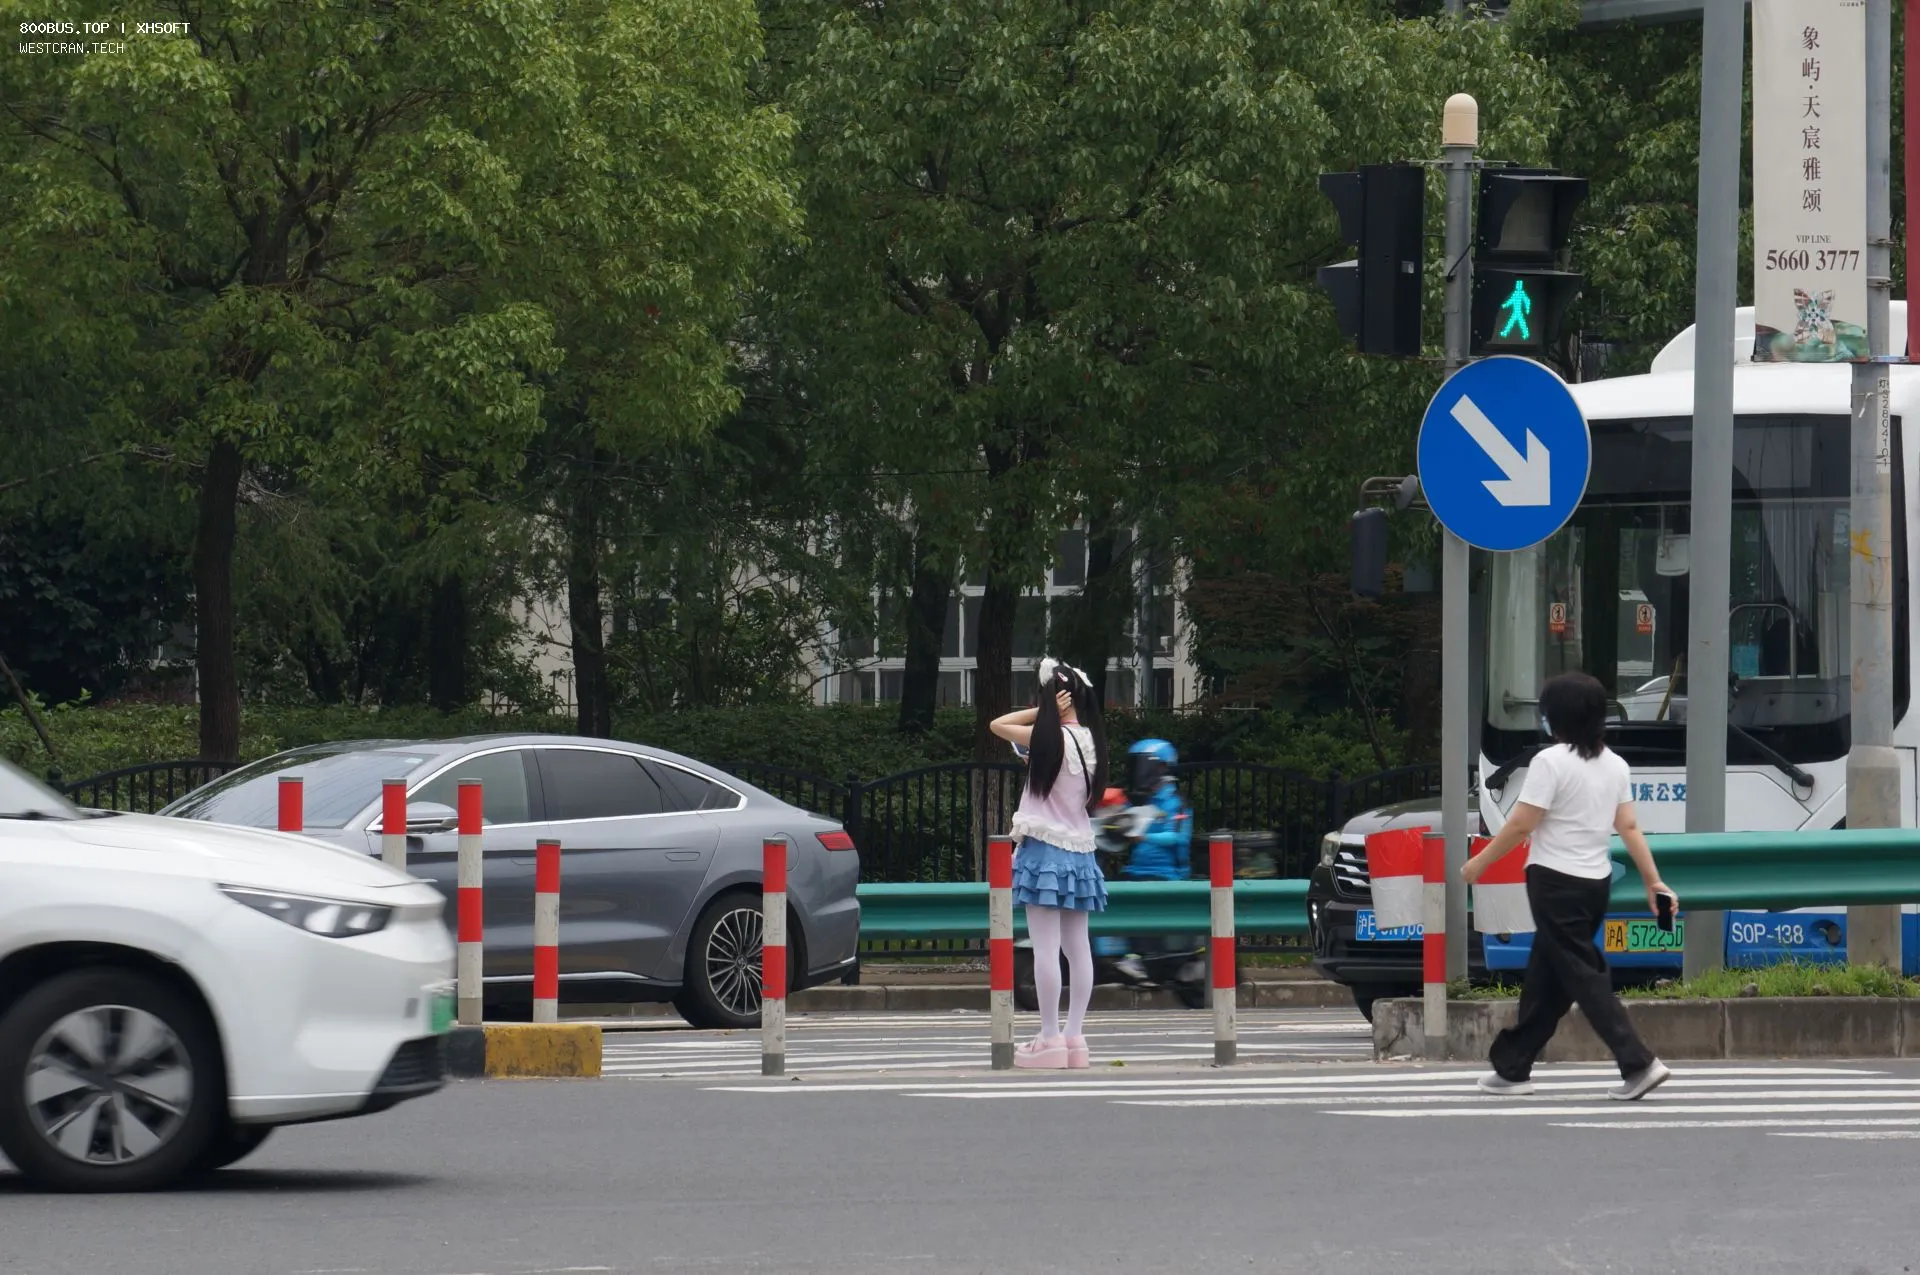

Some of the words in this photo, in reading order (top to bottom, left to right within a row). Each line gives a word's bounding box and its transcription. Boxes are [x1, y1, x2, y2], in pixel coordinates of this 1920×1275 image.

[1796, 234, 1810, 244] VIP
[1811, 234, 1832, 244] LINE
[1766, 249, 1810, 271] 5660
[1815, 249, 1860, 271] 3777
[1630, 782, 1686, 802] 东公交
